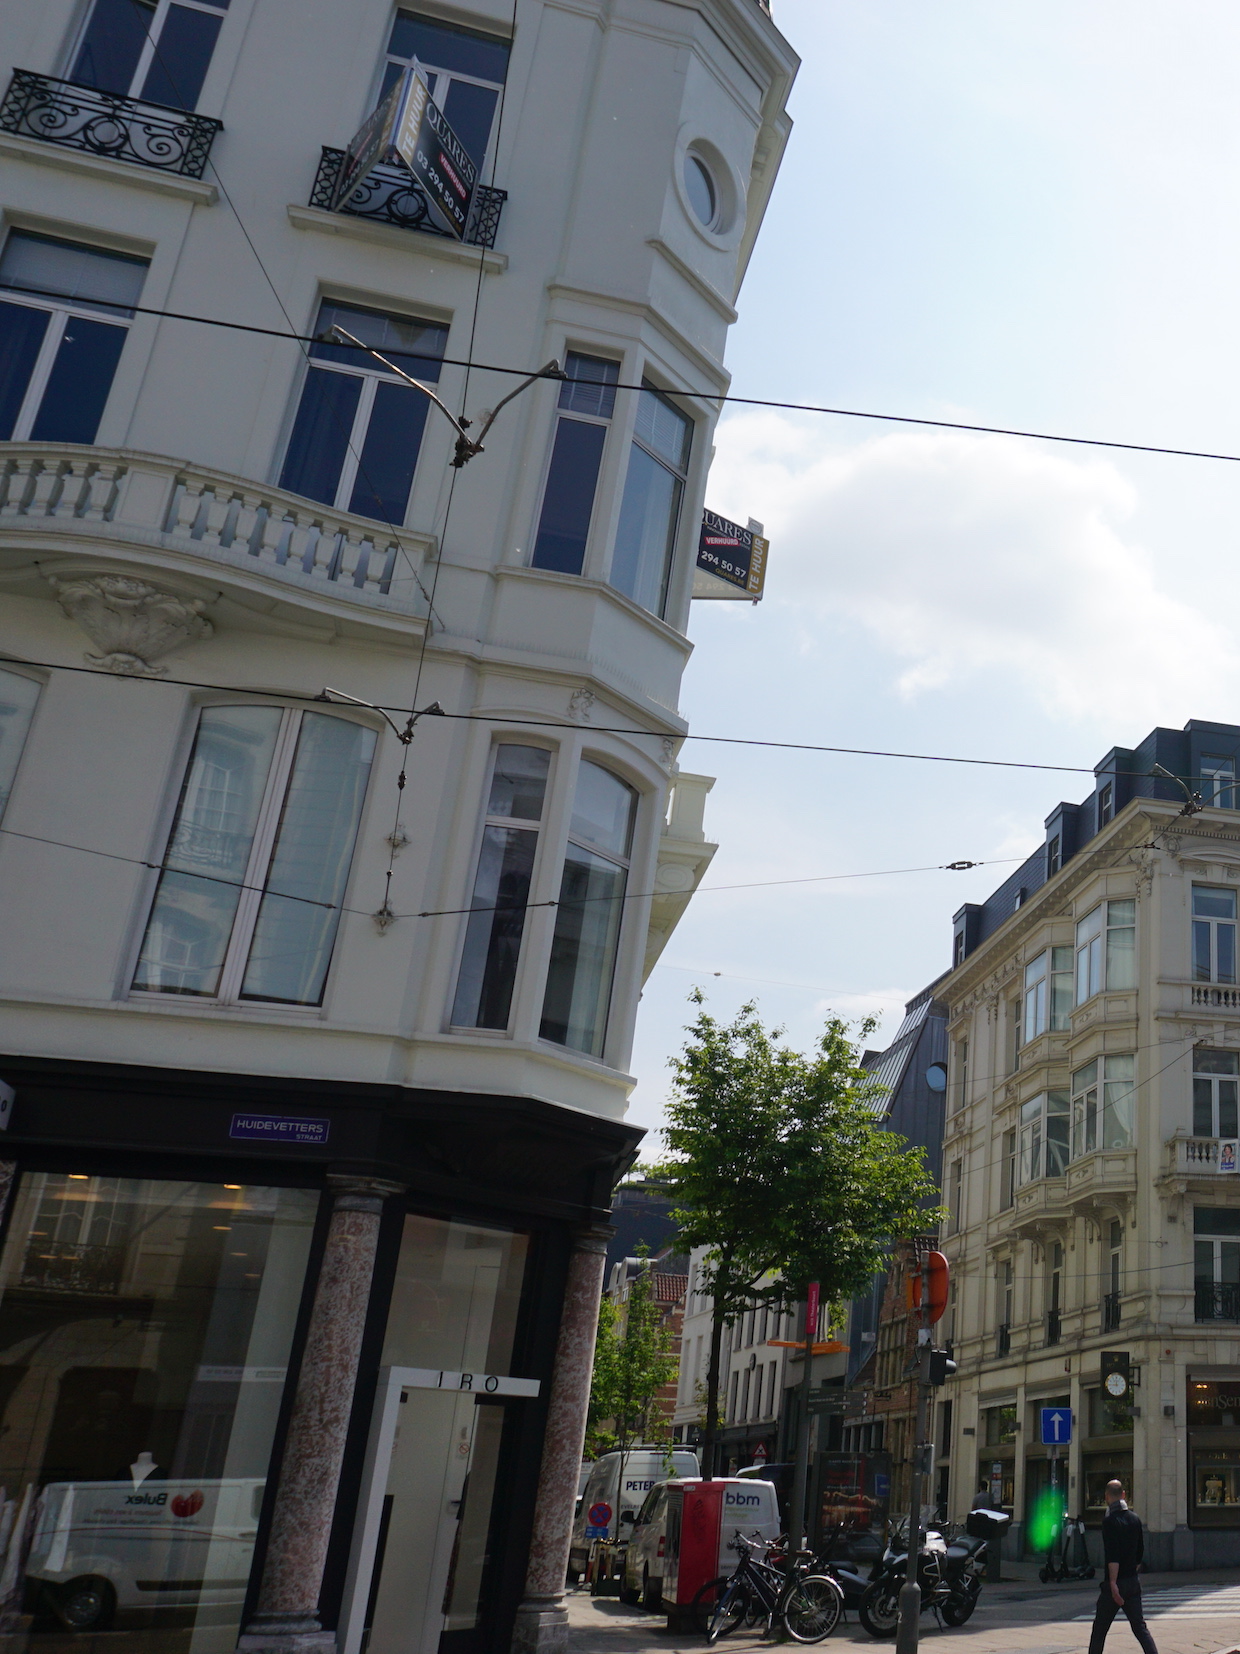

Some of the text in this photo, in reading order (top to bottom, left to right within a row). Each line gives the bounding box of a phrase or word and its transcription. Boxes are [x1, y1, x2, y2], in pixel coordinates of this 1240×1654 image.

[402, 84, 428, 156] TE HUUR
[426, 102, 475, 184] QUARES
[417, 150, 429, 170] 03
[428, 167, 443, 193] 294
[443, 190, 455, 207] 50
[453, 206, 465, 223] 57
[440, 152, 467, 200] VERHUURD
[706, 537, 739, 546] VERHUURD
[701, 550, 747, 578] 294 50 57
[749, 538, 765, 590] TE HUUR
[237, 1120, 324, 1133] HUIDEVETTERS
[438, 1371, 498, 1392] IRO
[725, 1492, 760, 1506] bbm
